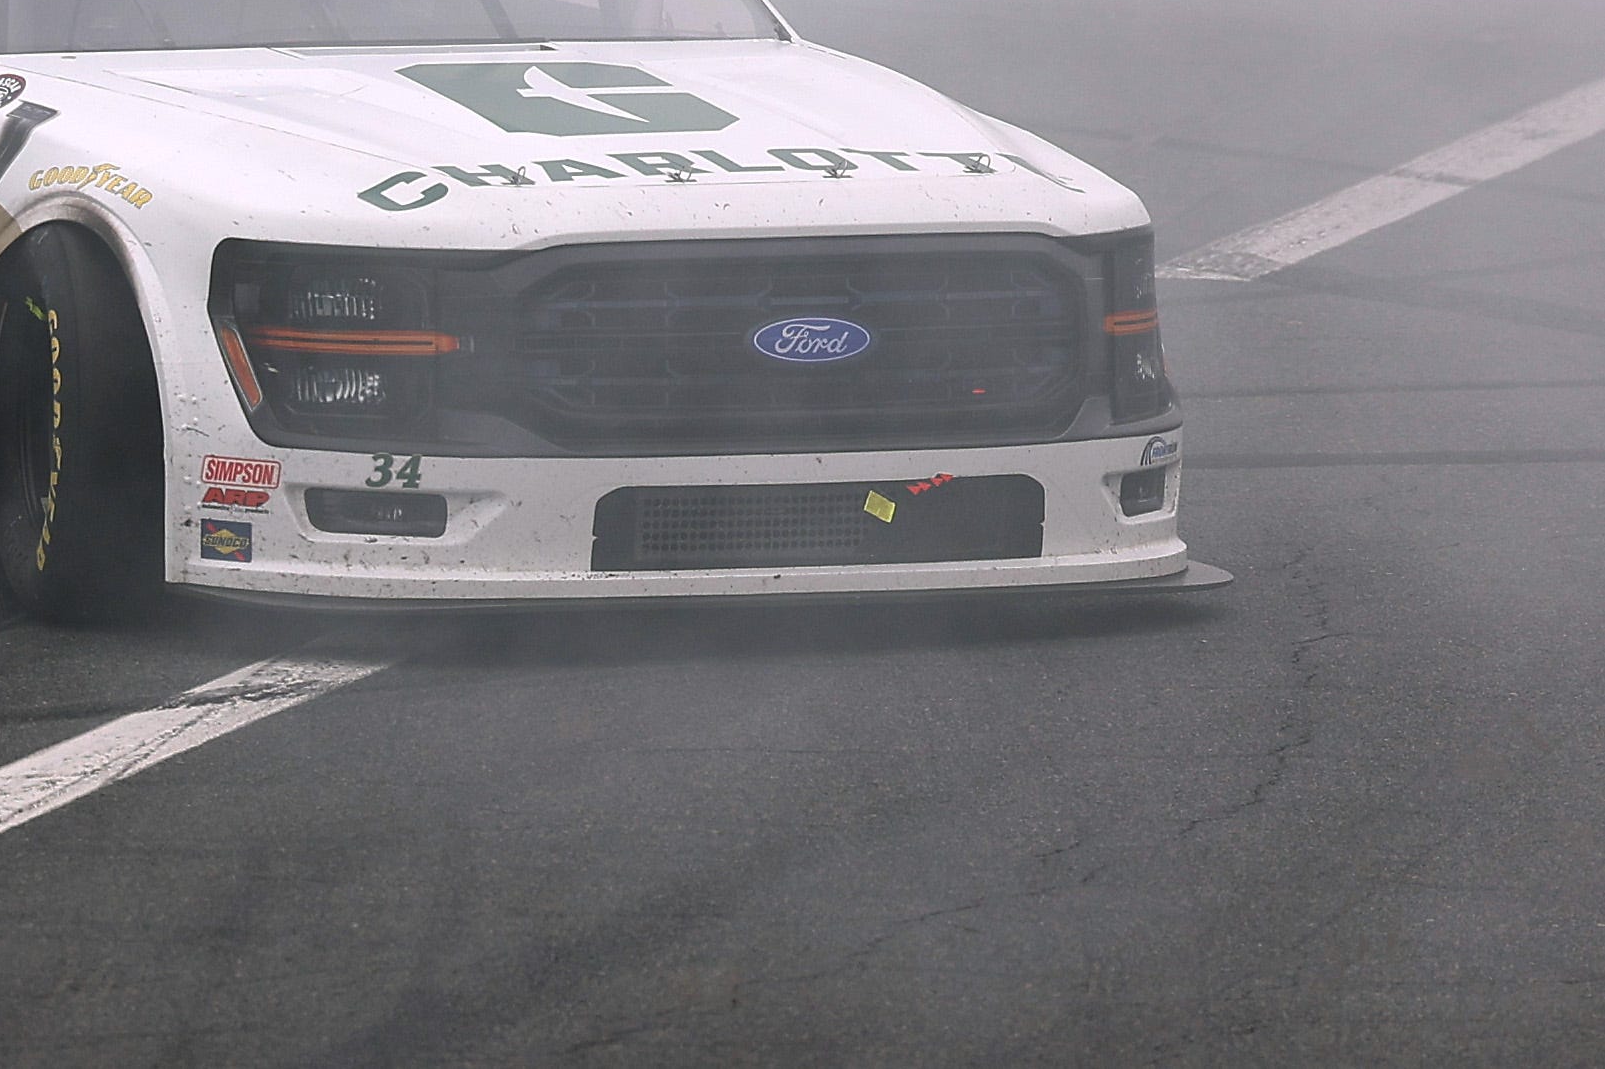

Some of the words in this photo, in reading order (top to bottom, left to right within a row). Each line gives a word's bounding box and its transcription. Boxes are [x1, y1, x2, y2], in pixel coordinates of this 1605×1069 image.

[28, 163, 153, 209] GOODYEAR
[775, 323, 848, 355] Ford
[205, 459, 276, 485] SIMPSON
[365, 452, 422, 489] 34
[201, 487, 270, 507] ARP
[203, 535, 249, 548] SUNOCO
